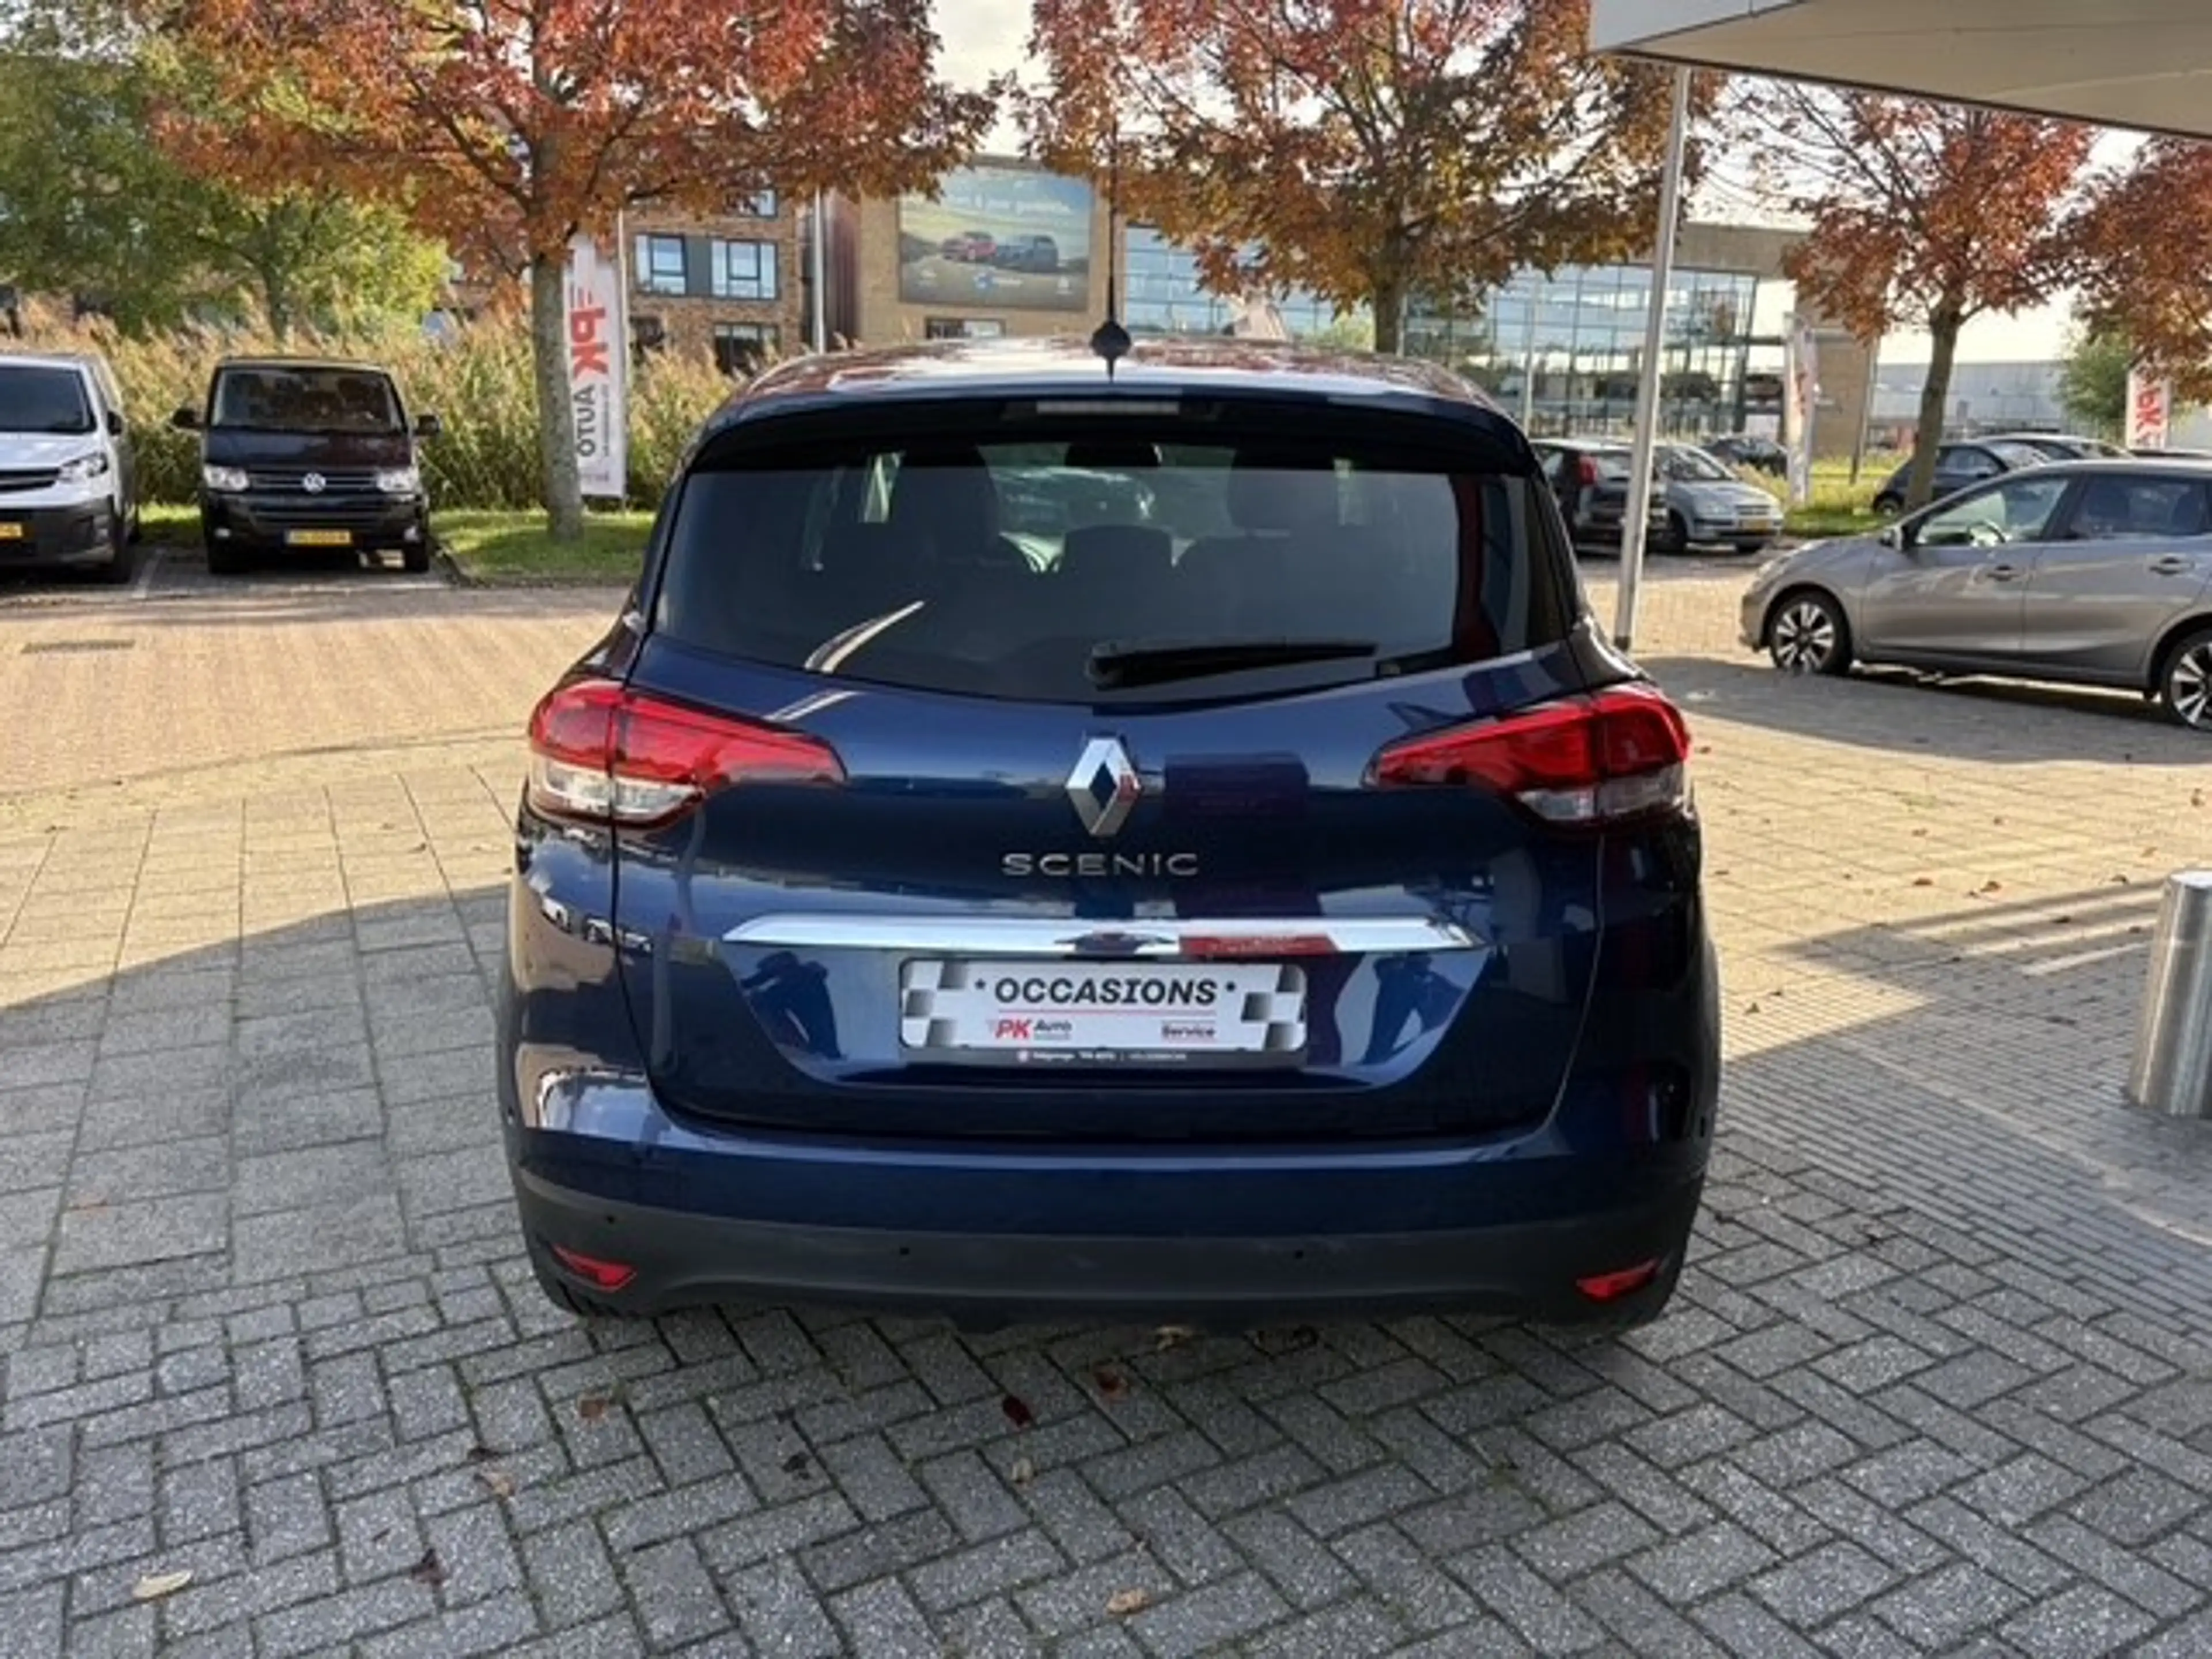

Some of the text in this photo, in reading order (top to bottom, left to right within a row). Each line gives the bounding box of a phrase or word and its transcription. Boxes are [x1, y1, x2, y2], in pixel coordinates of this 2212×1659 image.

[570, 307, 610, 378] PK
[573, 382, 596, 458] AUTO
[1001, 853, 1199, 876] SCENIC
[995, 978, 1218, 1005] OCCASIONS
[995, 1019, 1032, 1039] PK
